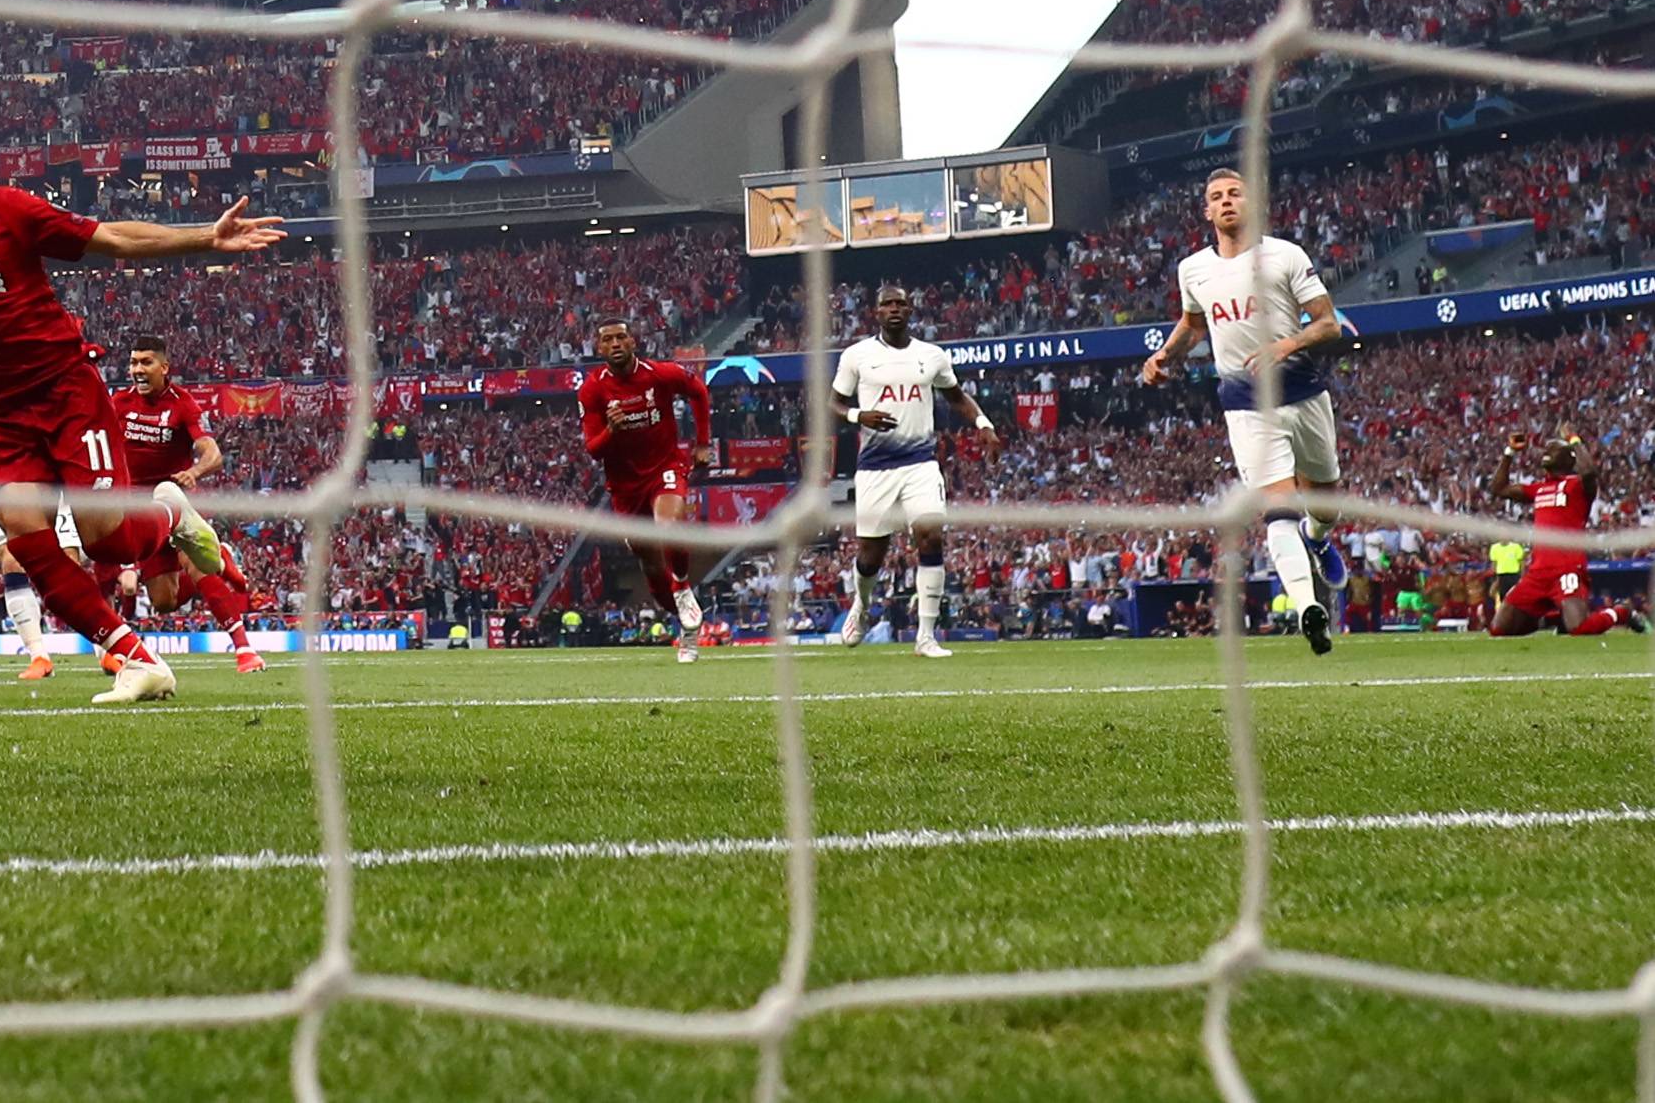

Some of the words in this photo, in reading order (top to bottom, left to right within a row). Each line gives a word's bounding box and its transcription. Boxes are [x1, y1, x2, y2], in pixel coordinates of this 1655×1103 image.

[146, 145, 174, 156] CLASS
[175, 145, 199, 157] HERO
[146, 159, 155, 170] IS
[156, 159, 206, 170] SOMETHING
[208, 158, 220, 169] TO
[220, 157, 232, 168] BE
[1499, 291, 1541, 313] UEFA
[1542, 283, 1629, 308] CAMPIONS
[1212, 295, 1269, 327] AIA
[993, 343, 1007, 364] 19
[1014, 338, 1085, 360] FINAL
[879, 384, 923, 403] AIA
[1017, 394, 1032, 407] THE
[1033, 394, 1055, 407] REAL
[124, 430, 161, 443] Chartered
[126, 421, 161, 435] Standard
[81, 428, 115, 472] 11
[1559, 572, 1579, 591] 10
